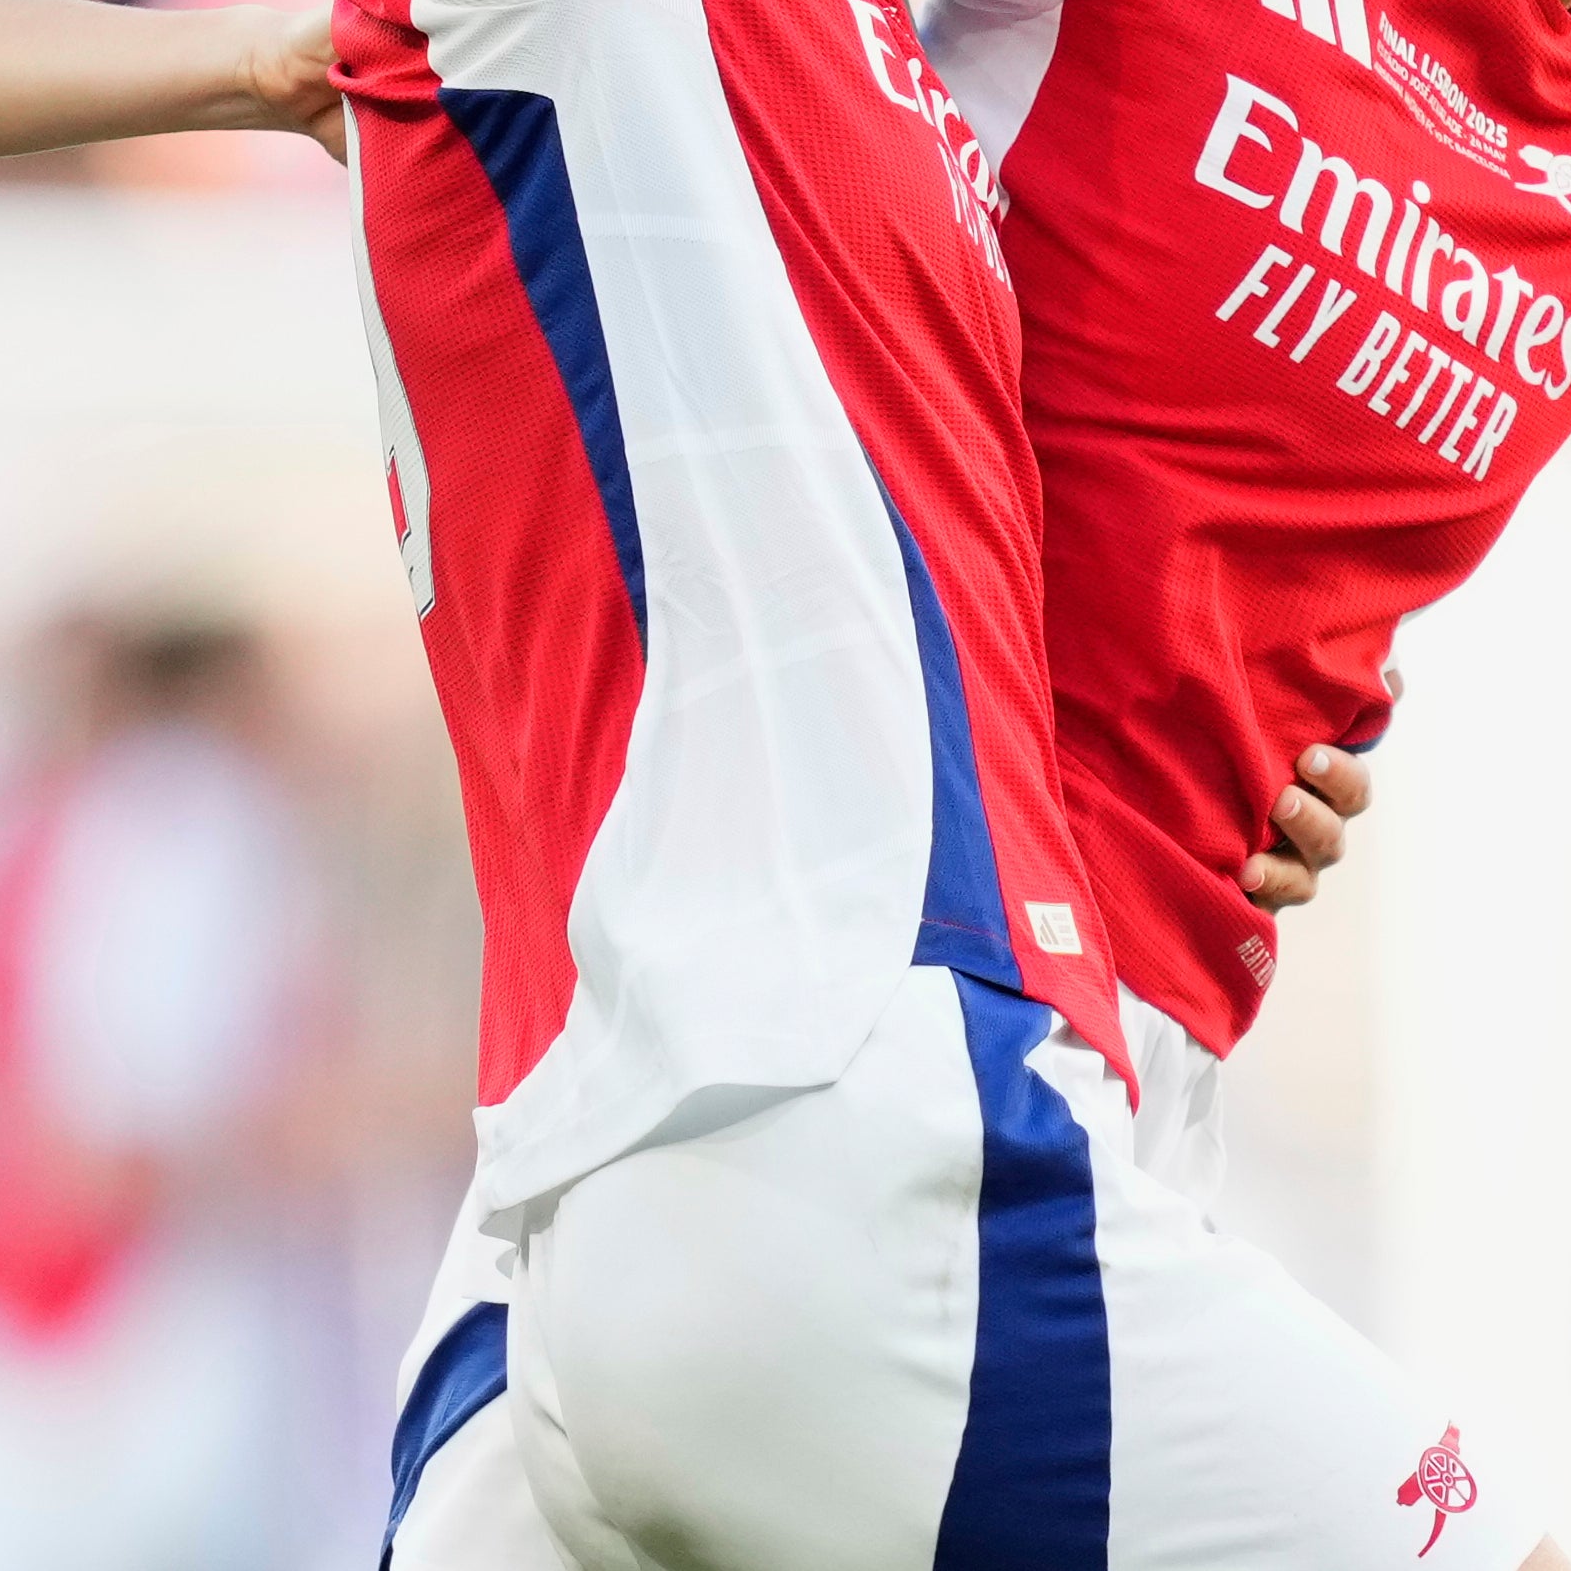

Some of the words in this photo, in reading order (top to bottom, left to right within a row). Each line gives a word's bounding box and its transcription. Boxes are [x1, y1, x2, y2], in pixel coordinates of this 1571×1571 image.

[1379, 10, 1418, 70] FINAL
[1420, 53, 1469, 119] LISBON
[1465, 103, 1508, 149] 2025
[1215, 243, 1357, 364] FLY
[1336, 309, 1518, 482] BETTER
